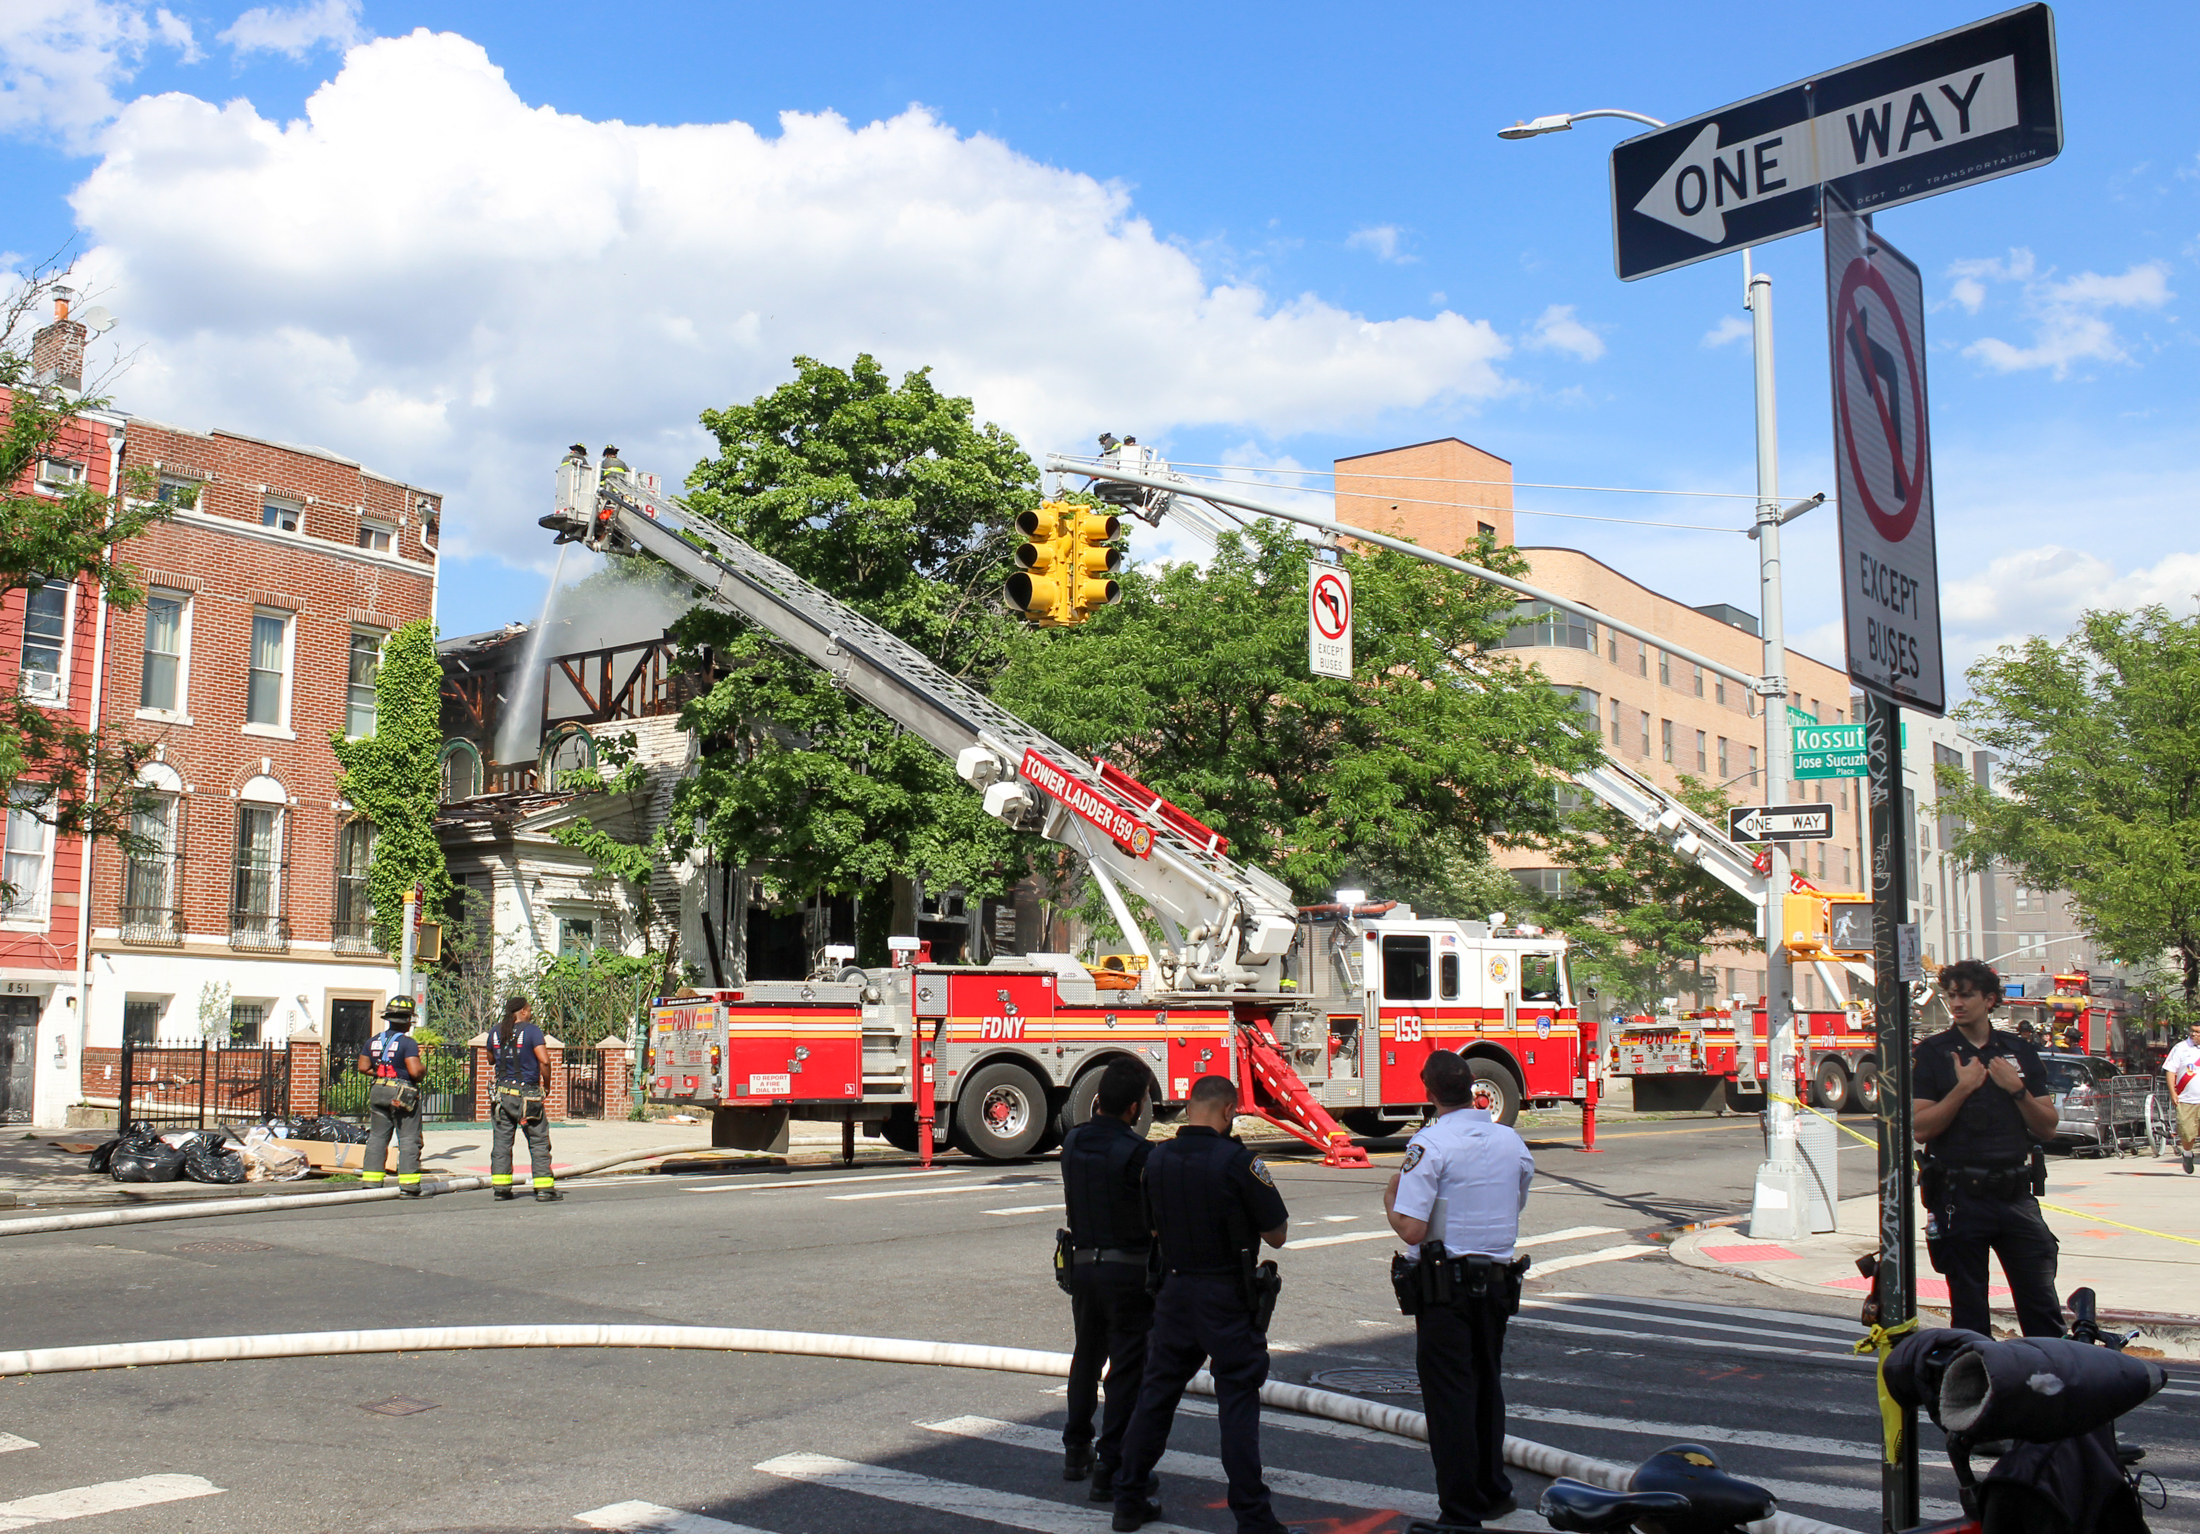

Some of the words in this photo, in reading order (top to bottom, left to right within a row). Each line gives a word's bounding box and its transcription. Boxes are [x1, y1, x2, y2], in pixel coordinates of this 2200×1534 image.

[1675, 136, 1787, 217] ONE
[1846, 72, 1985, 165] WAY
[1857, 192, 1885, 204] DEPT
[1899, 184, 1912, 192] OF
[1927, 150, 2036, 184] TRANSPORTATION
[1860, 551, 1918, 620] EXCEPT
[1318, 643, 1344, 657] EXCEPT
[1867, 616, 1919, 679] BUSES
[1320, 658, 1343, 671] BUSES
[1797, 727, 1866, 749] Kossut
[1796, 756, 1822, 769] Jose
[1826, 752, 1868, 768] Sucuzh
[1836, 768, 1855, 776] Place
[1025, 754, 1066, 797] TOWER
[1064, 782, 1114, 830] LADDER
[1112, 814, 1134, 841] 159
[1746, 817, 1772, 831] ONE
[1792, 815, 1822, 829] WAY
[8, 983, 29, 993] 851
[672, 1007, 698, 1031] FDNY
[981, 1017, 1025, 1039] FDNY
[1395, 1016, 1422, 1042] 159
[1640, 1031, 1672, 1045] FDNY
[1820, 1035, 1837, 1047] FDNY
